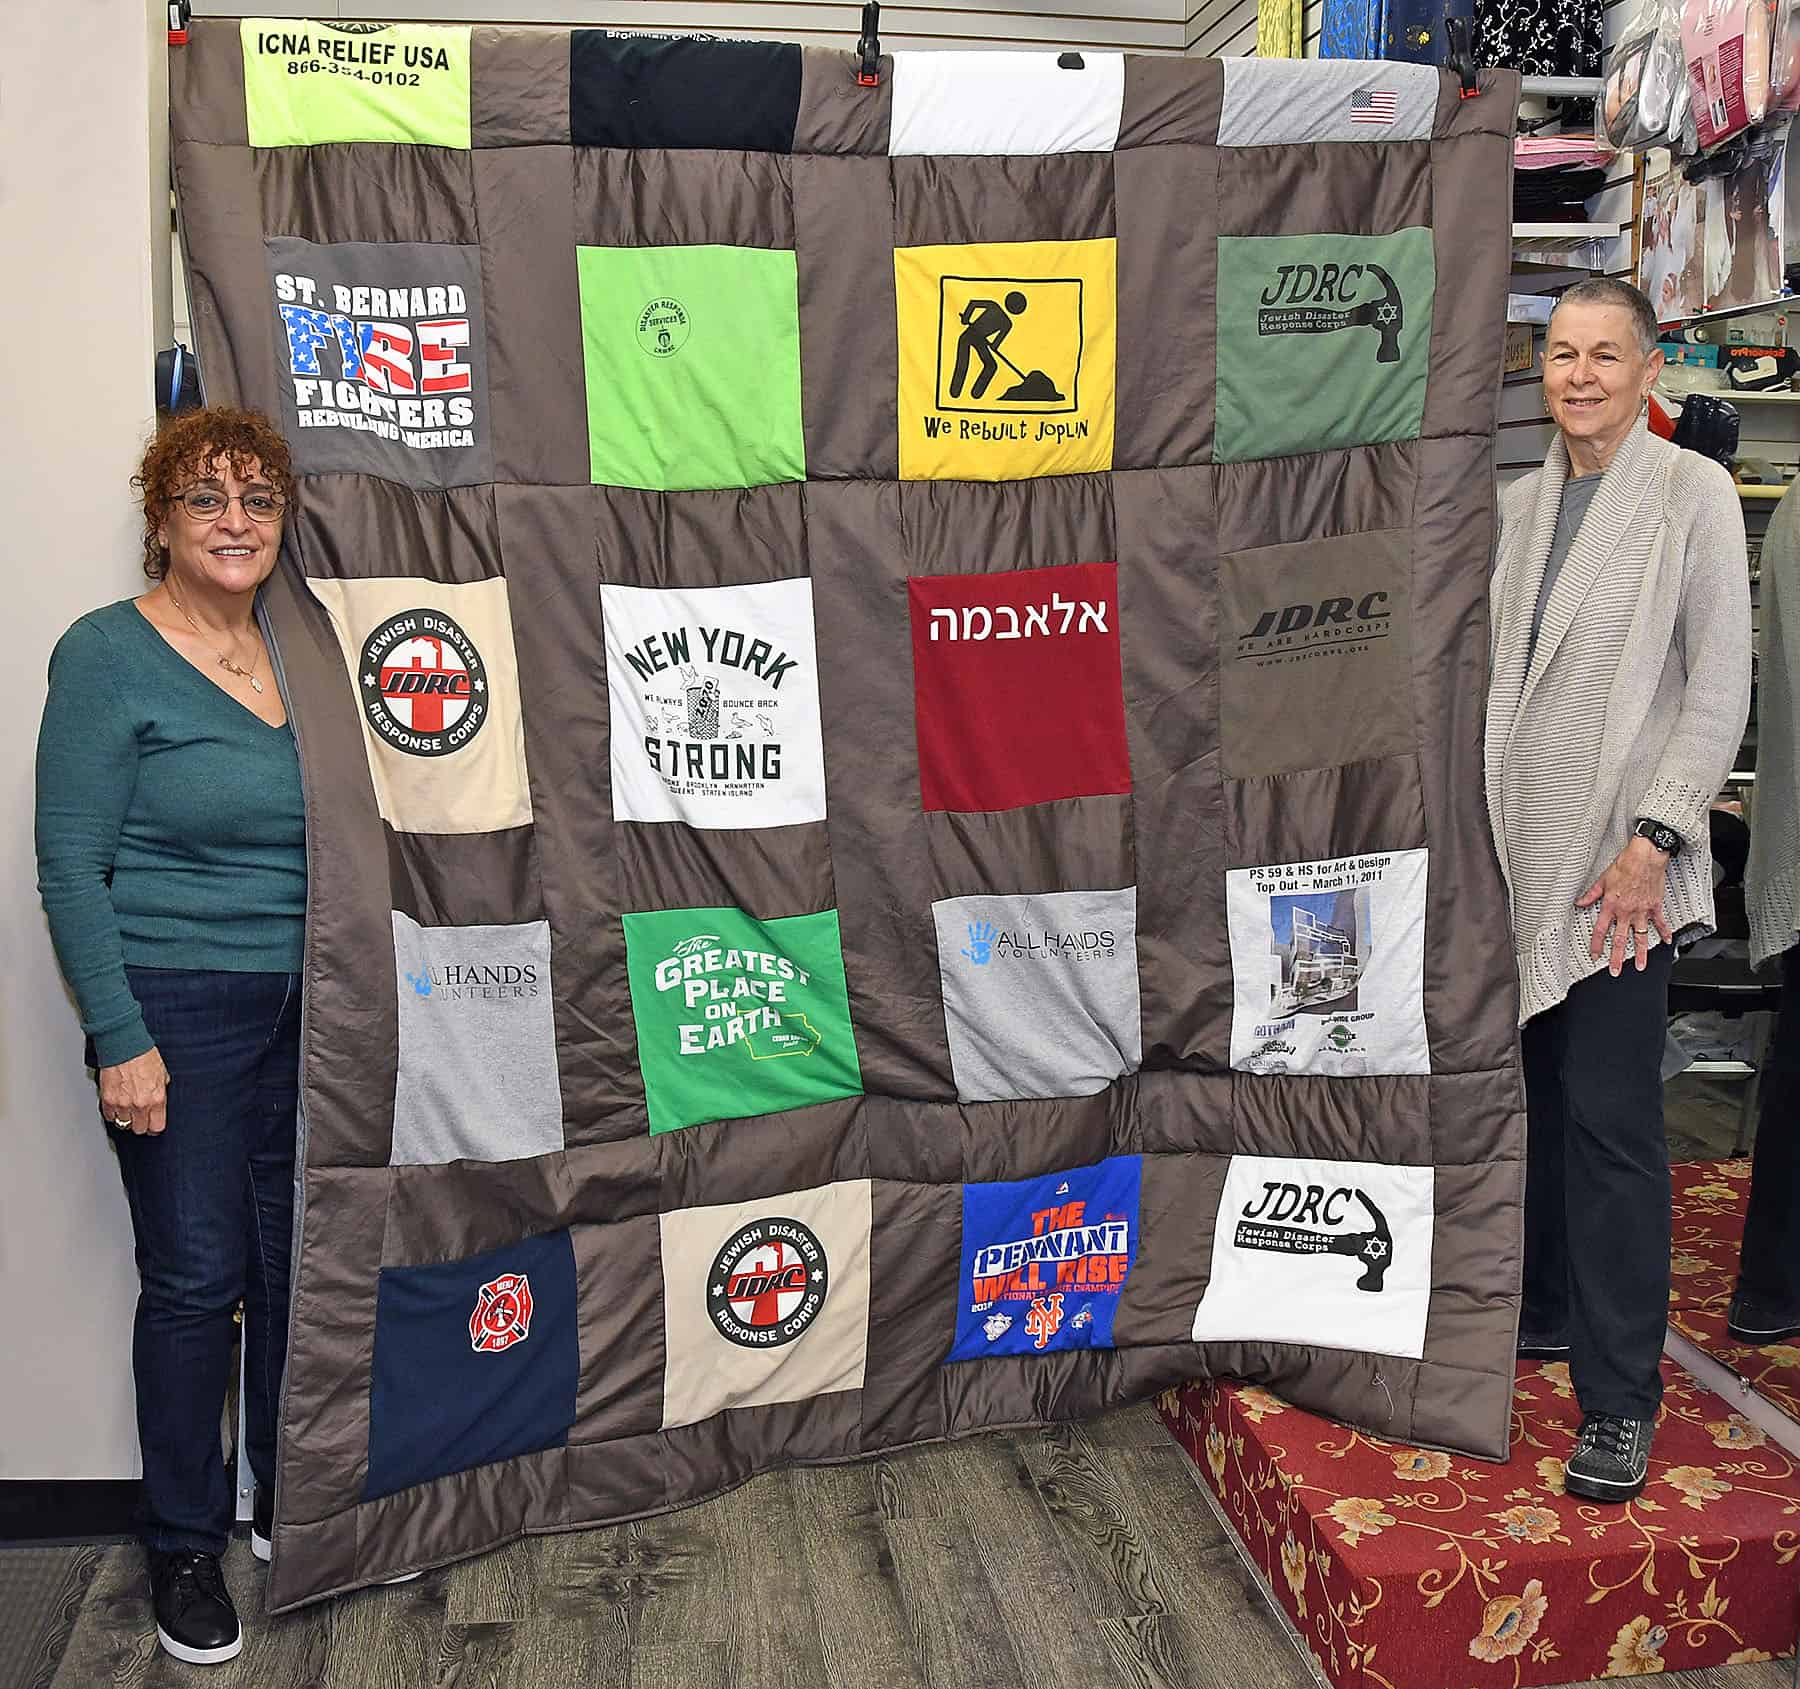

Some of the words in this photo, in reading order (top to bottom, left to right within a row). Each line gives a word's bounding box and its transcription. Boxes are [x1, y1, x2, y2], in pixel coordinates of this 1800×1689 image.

[258, 33, 311, 55] ICNA
[317, 39, 396, 65] RELIEF
[403, 45, 450, 71] USA
[275, 274, 325, 307] ST.
[332, 285, 467, 317] BERNARD
[1261, 263, 1363, 305] JDRC
[1260, 311, 1301, 322] Jewish
[1305, 311, 1351, 320] Disaster
[1260, 321, 1313, 331] Response
[1315, 319, 1347, 329] Corps
[278, 304, 472, 395] FIRE
[293, 378, 474, 428] FIGHTERS
[298, 409, 400, 440] REBUILDING
[924, 416, 952, 438] We
[929, 592, 1109, 641] אלאבמה
[1239, 591, 1391, 640] JDRC
[367, 618, 417, 663] JEWISH
[423, 617, 478, 670] DISASTER
[624, 627, 691, 683] NEW
[698, 627, 799, 690] YORK
[1238, 642, 1254, 652] WE
[1267, 636, 1293, 649] ARE
[381, 671, 471, 695] JDRC
[723, 699, 754, 708] BOUNCE
[757, 699, 779, 708] BACK
[369, 702, 442, 750] RESPONSE
[449, 703, 483, 745] CORPS
[645, 735, 781, 780] STRONG
[686, 781, 718, 789] BROOKLYN
[724, 782, 765, 790] MANHATTAN
[702, 789, 726, 797] STATEN
[1250, 868, 1265, 880] PS
[1268, 867, 1282, 878] 59
[1286, 866, 1294, 877] &
[1298, 865, 1313, 876] HS
[1317, 864, 1332, 875] for
[1334, 862, 1347, 872] Art
[1349, 861, 1356, 871] &
[1358, 856, 1391, 869] Design
[1256, 882, 1275, 894] Top
[1280, 880, 1299, 891] Out
[1313, 875, 1343, 890] March
[1346, 874, 1359, 886] 11,
[1361, 870, 1383, 883] 2011
[672, 935, 720, 957] The
[997, 931, 1040, 950] ALL
[1045, 930, 1115, 951] HANDS
[997, 949, 1115, 961] VOLUNTEERS
[444, 965, 537, 985] HANDS
[655, 949, 811, 992] GREATEST
[440, 984, 538, 1001] UNTEERS
[684, 976, 787, 1008] PLACE
[705, 1001, 737, 1020] ON
[678, 1007, 782, 1055] EARTH
[1031, 1201, 1086, 1236] THE
[1242, 1182, 1353, 1226] JDRC
[719, 1228, 762, 1274] JEWISH
[769, 1225, 819, 1262] DISASTER
[978, 1224, 1125, 1274] PENNANT
[1236, 1234, 1291, 1248] Response
[1294, 1240, 1329, 1253] Corps
[1237, 1226, 1279, 1239] Jewish
[1283, 1231, 1336, 1244] Disaster
[728, 1267, 806, 1297] JDRC
[973, 1262, 1046, 1304] WILL
[1056, 1255, 1129, 1284] RISE
[717, 1309, 778, 1342] RESPONSE
[783, 1293, 819, 1335] CORPS
